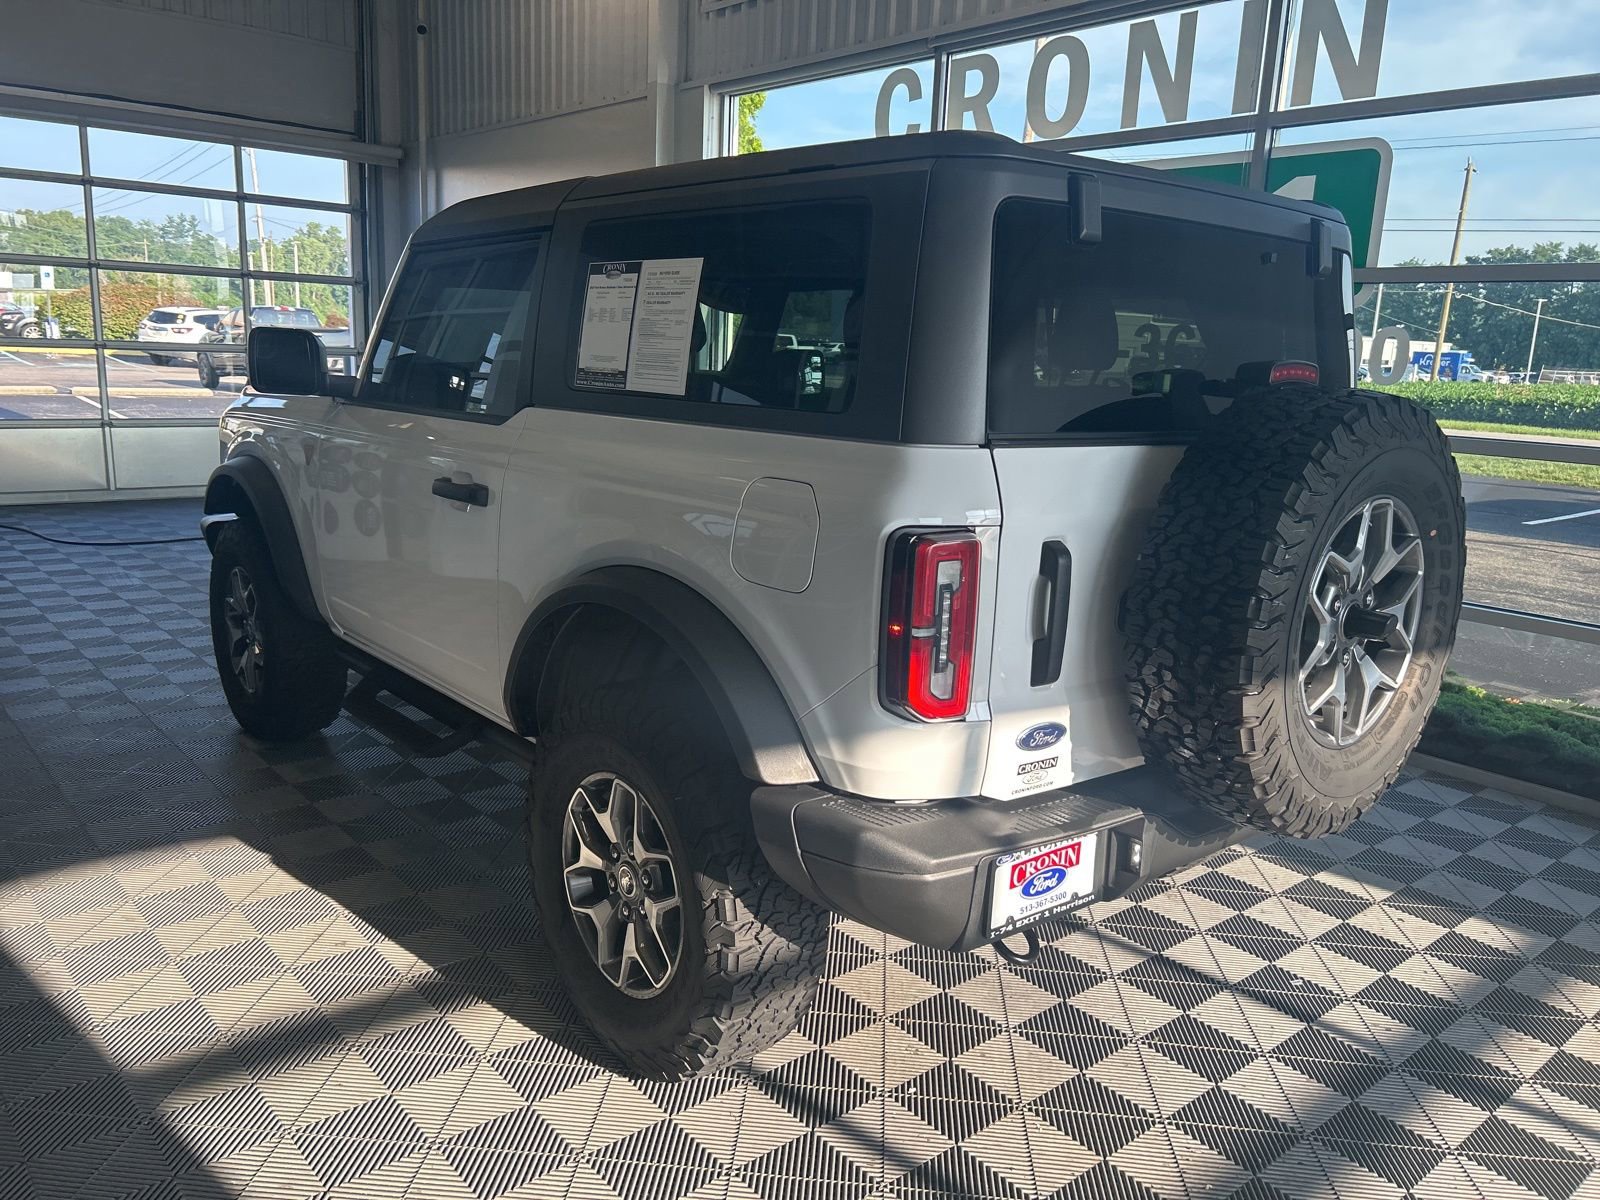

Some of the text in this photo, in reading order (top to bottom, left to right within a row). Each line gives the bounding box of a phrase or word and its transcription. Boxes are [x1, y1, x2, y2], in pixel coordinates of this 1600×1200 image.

[875, 0, 1389, 141] CRONIN
[602, 263, 627, 274] CRONIN
[1029, 728, 1058, 747] Ford
[1018, 757, 1058, 774] CRONIN
[1013, 846, 1080, 887] CRONIN
[1029, 871, 1060, 895] Ford
[1019, 891, 1068, 915] 513-367-5300
[990, 893, 1096, 940] I-74 EXIT 1 Harrison
